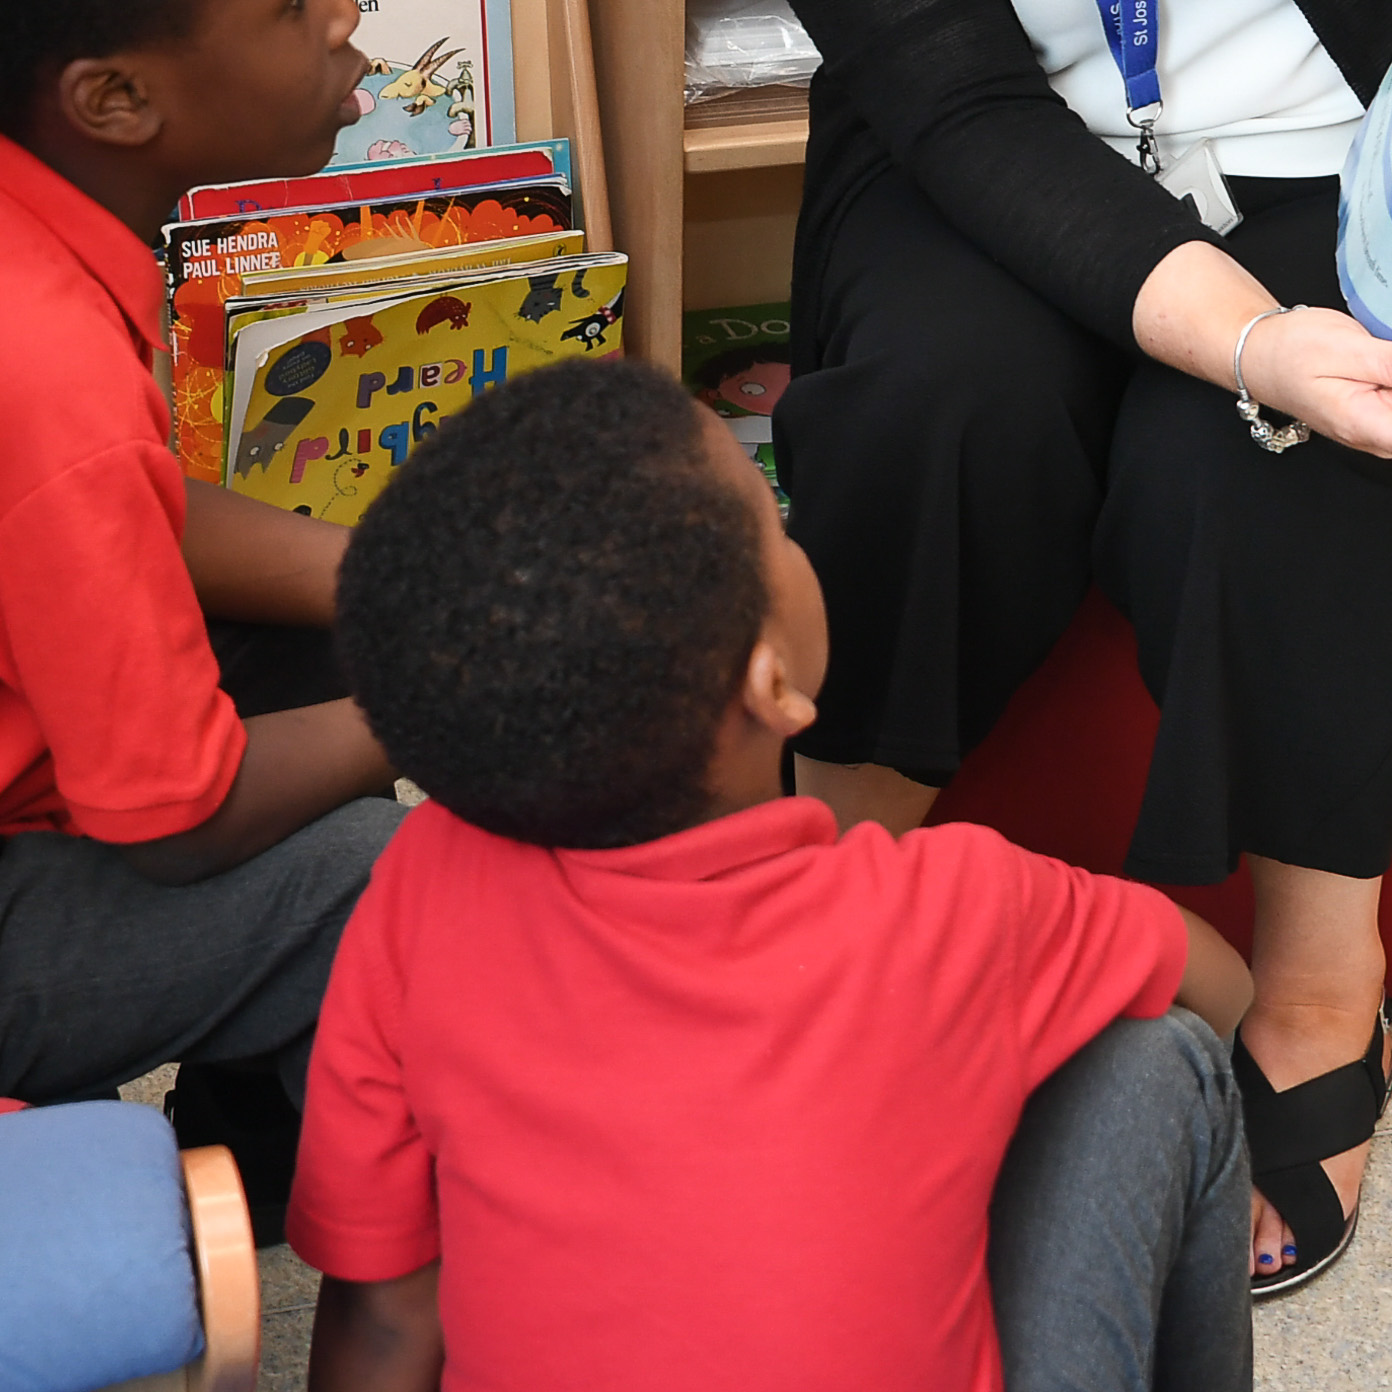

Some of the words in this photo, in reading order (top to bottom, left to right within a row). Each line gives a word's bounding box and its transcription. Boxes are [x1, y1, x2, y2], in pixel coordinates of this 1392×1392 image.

[1134, 28, 1149, 46] St
[181, 238, 212, 258] SUE
[216, 231, 279, 255] HENDRA
[182, 257, 221, 280] PAUL
[225, 251, 282, 276] LINNET
[355, 345, 510, 409] Heard
